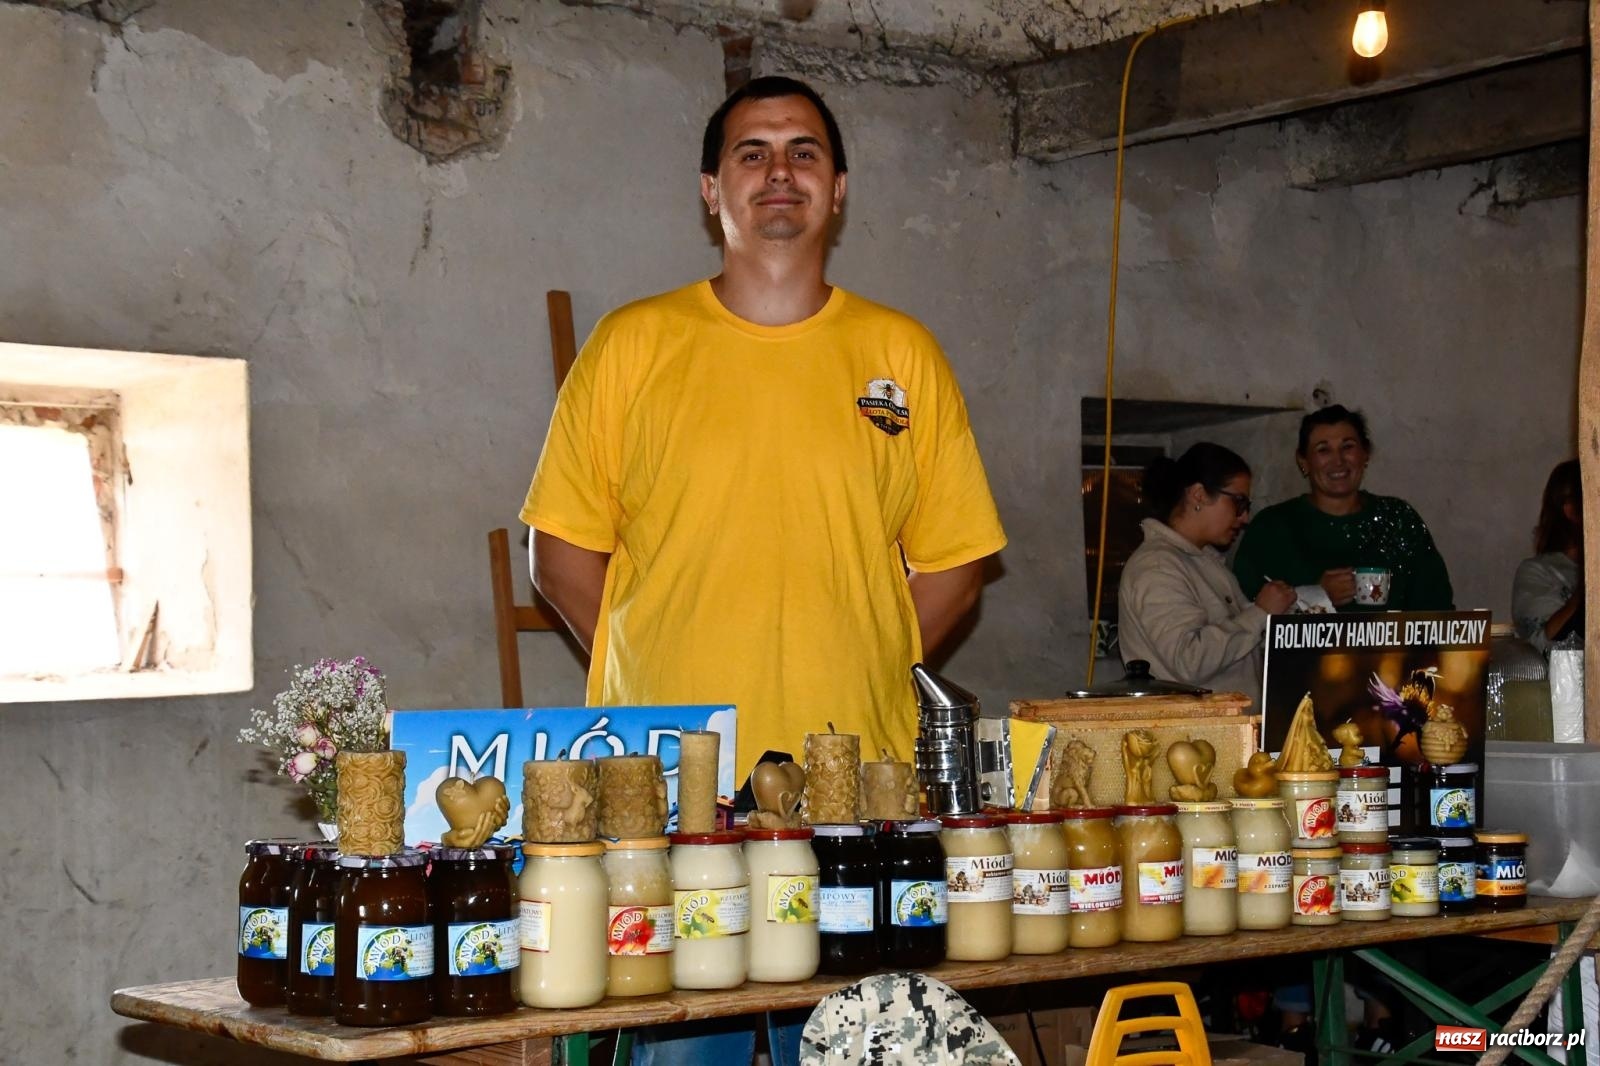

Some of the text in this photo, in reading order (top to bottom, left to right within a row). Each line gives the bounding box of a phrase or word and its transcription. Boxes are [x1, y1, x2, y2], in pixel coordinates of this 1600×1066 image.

[1274, 619, 1488, 649] ROLNICZY HANDEL DETALICZNY
[970, 856, 1006, 870] Miód
[1257, 852, 1292, 867] MIÓD
[1083, 867, 1121, 886] MIÓD
[1496, 860, 1527, 878] MIÓ
